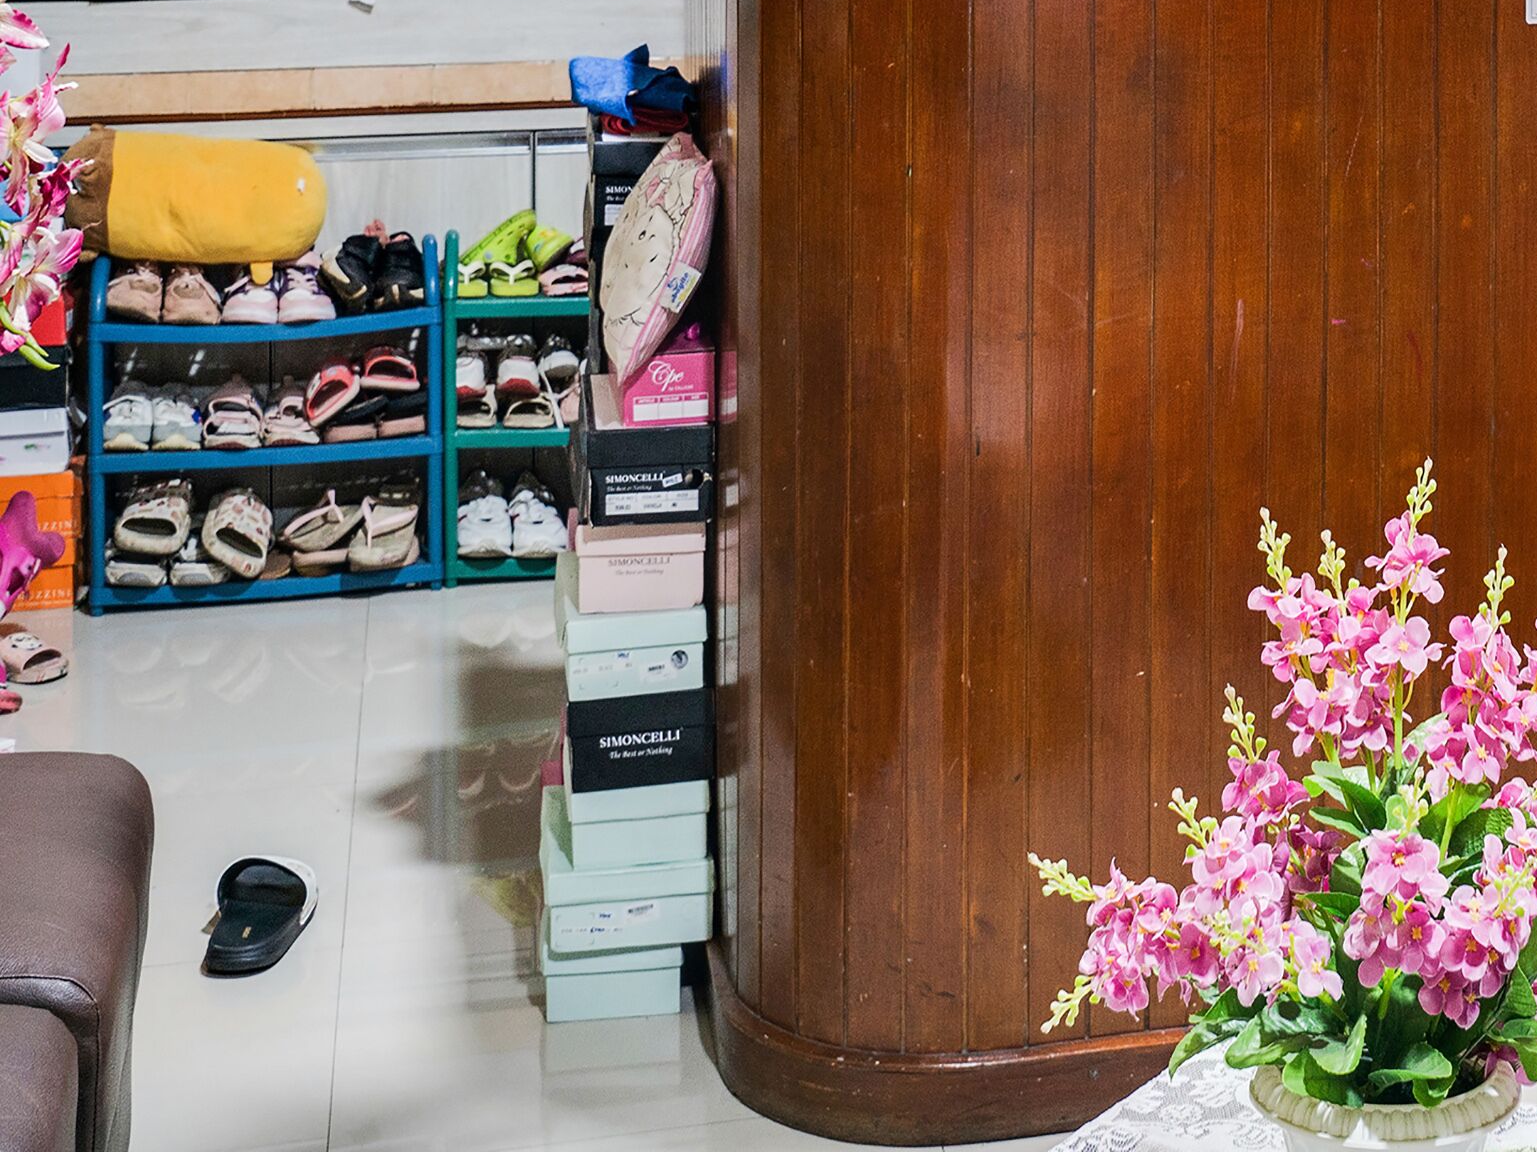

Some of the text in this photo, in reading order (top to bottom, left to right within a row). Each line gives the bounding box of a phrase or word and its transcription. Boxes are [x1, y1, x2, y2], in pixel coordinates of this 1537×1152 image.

[605, 472, 664, 484] SIMONCELLI
[608, 556, 670, 567] SIMONCELLI
[599, 729, 680, 749] SIMONCELLI
[609, 750, 621, 759] The
[622, 750, 637, 758] Best
[646, 745, 673, 756] Nothing
